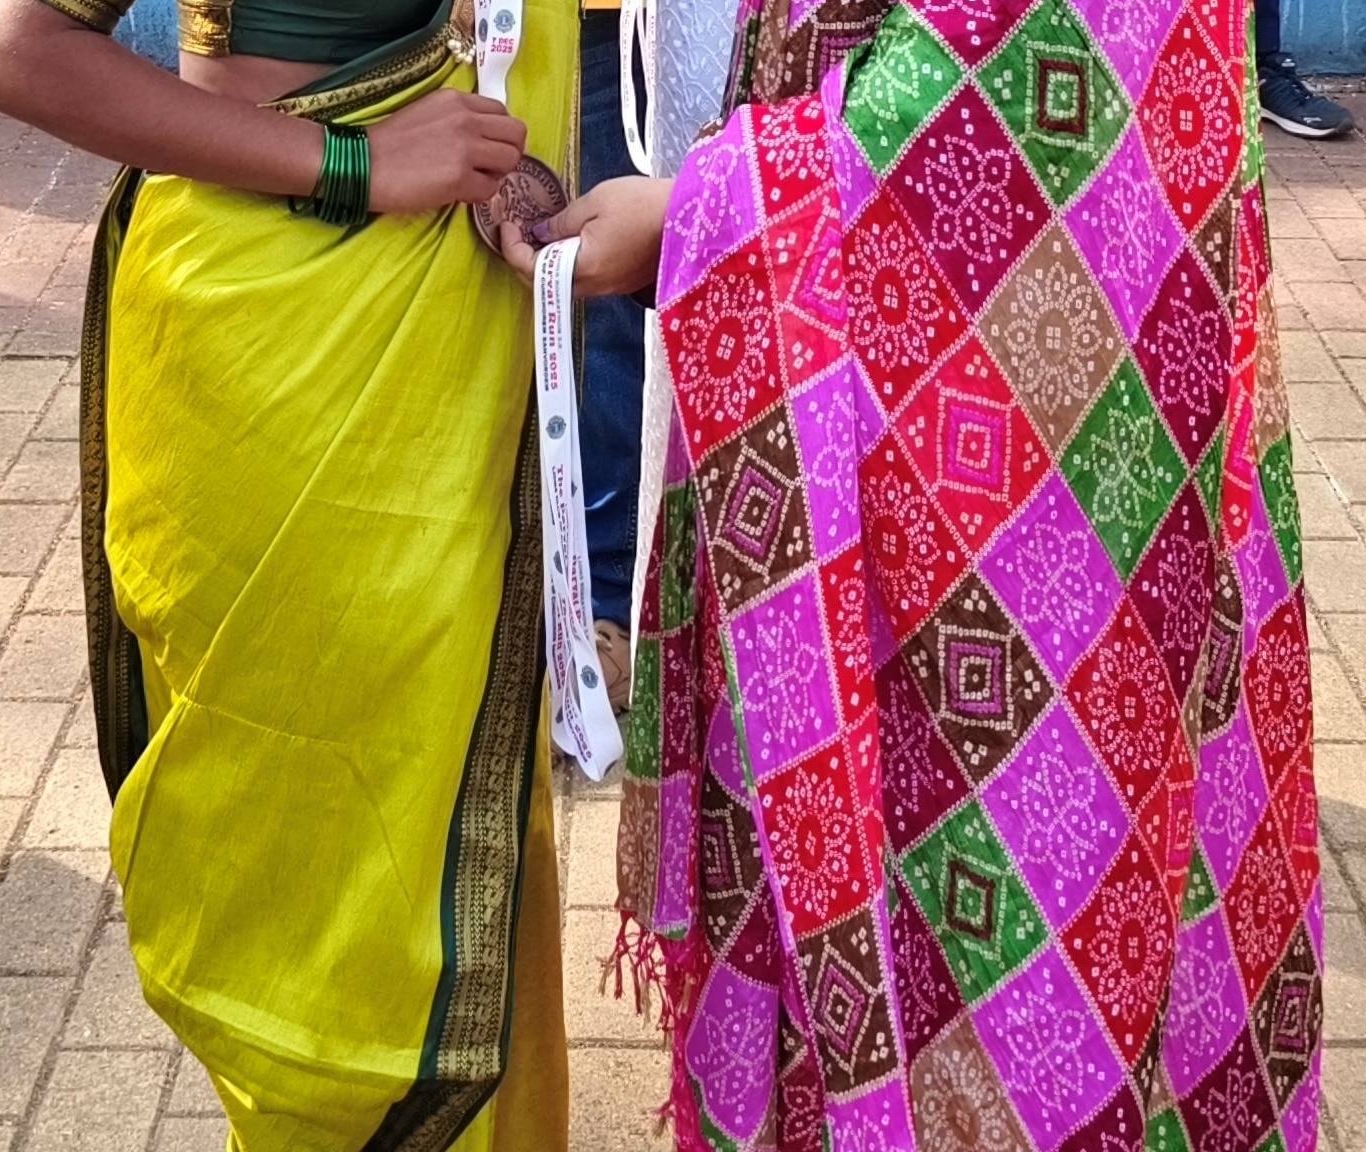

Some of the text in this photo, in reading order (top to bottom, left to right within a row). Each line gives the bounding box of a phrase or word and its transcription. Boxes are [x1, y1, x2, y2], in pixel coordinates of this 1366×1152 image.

[491, 45, 514, 53] 2025
[547, 249, 558, 390] Parvat Run 2025
